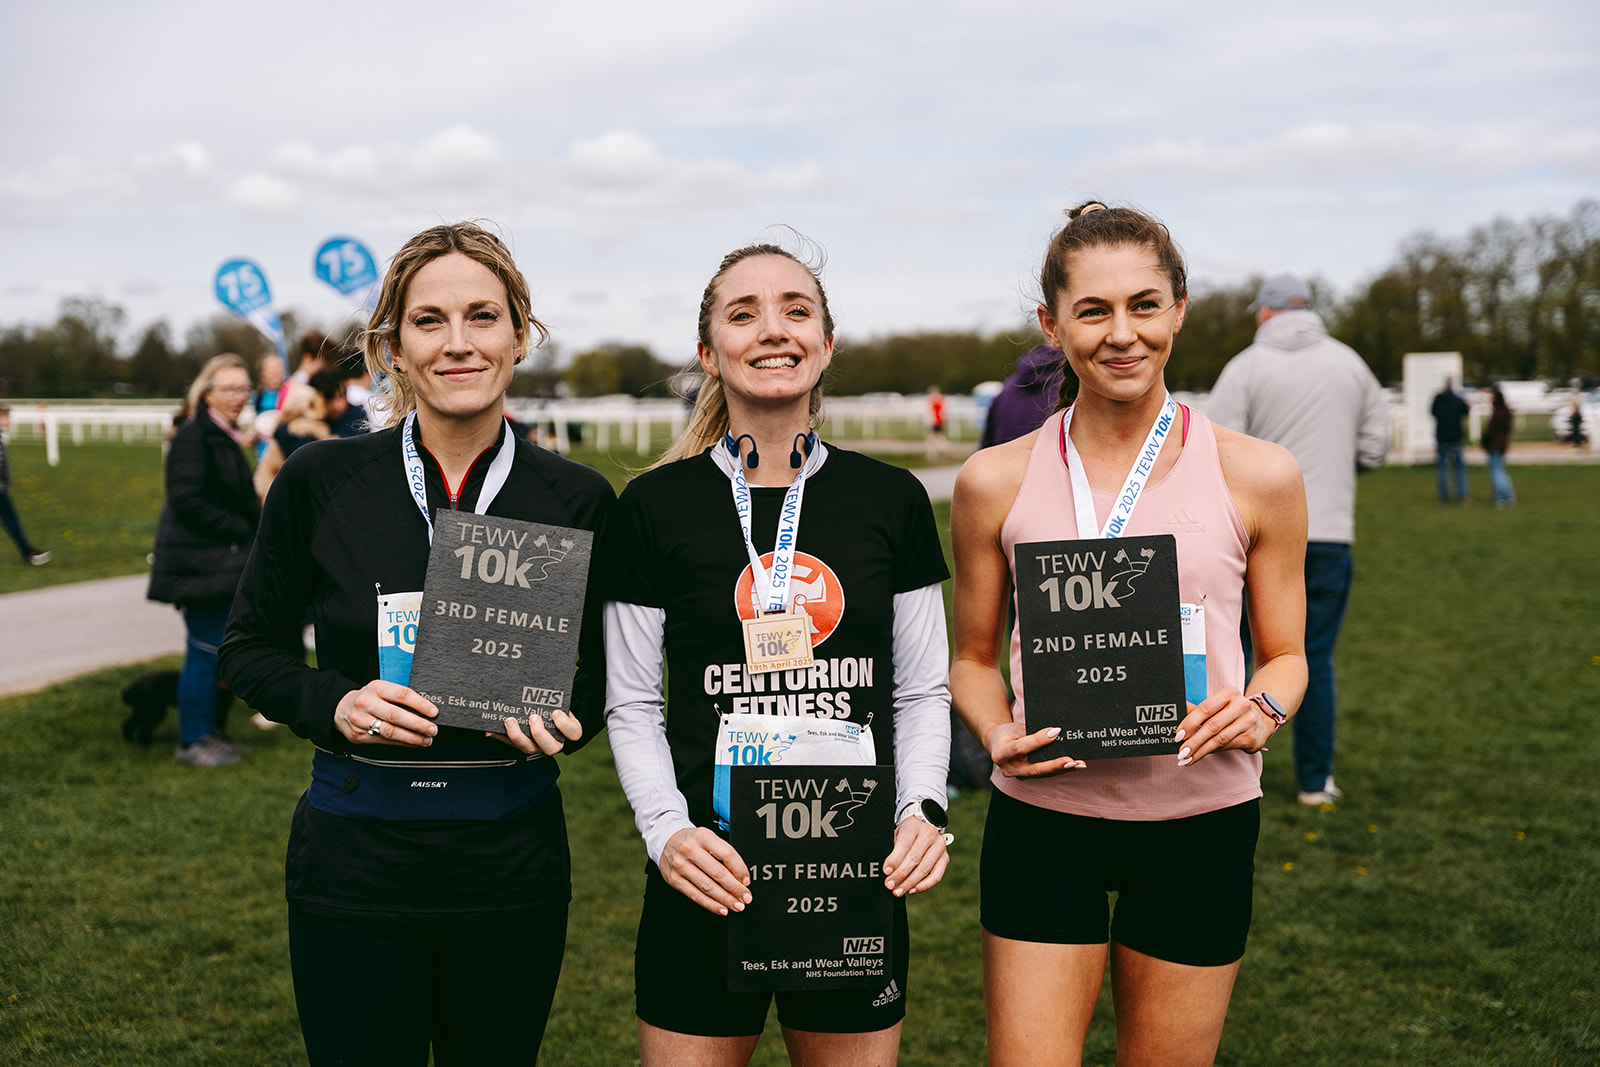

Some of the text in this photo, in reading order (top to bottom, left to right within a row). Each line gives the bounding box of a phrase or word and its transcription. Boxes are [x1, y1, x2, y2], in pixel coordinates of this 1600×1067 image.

[1119, 480, 1141, 514] 2025
[1135, 437, 1160, 477] TEWV
[1155, 413, 1172, 438] 10k
[410, 466, 424, 500] 2025
[783, 486, 799, 524] TEWV
[457, 522, 528, 549] TEWV
[778, 526, 793, 551] 10k
[454, 545, 534, 589] 10k
[772, 556, 789, 588] 2025
[1036, 551, 1106, 574] TEWV
[769, 593, 783, 610] TE
[1039, 571, 1121, 612] 10k
[386, 610, 421, 623] TEW
[435, 600, 569, 633] 3RD FEMALE
[388, 624, 418, 646] 10
[755, 631, 784, 642] TEWV
[1033, 629, 1168, 653] 2ND FEMALE
[471, 638, 523, 659] 2025
[757, 640, 790, 657] 10k
[750, 658, 813, 672] 19th April 2025
[1076, 666, 1127, 683] 2025
[704, 657, 873, 695] CENTURION
[523, 687, 563, 706] NHS
[733, 691, 851, 719] FITNESS
[448, 695, 466, 707] Esk
[469, 700, 489, 710] and
[492, 702, 521, 714] Wear
[523, 706, 553, 721] Valley
[481, 712, 497, 721] NHS
[1137, 704, 1176, 722] NHS
[728, 731, 768, 743] TEWV
[1066, 728, 1084, 739] Esk
[1087, 728, 1107, 738] and
[1109, 727, 1138, 738] Wear
[1140, 724, 1177, 737] Valleys
[1102, 739, 1117, 747] NHS
[1119, 737, 1159, 746] Foundation
[728, 744, 773, 765] 10k
[755, 779, 828, 799] TEWV
[755, 800, 839, 839] 10k
[750, 862, 880, 881] 1ST FEMALE
[787, 897, 838, 913] 2025
[844, 938, 884, 954] NHS
[741, 957, 884, 971] Tees, Esk and Wear Valleys
[872, 991, 901, 1007] adidas
